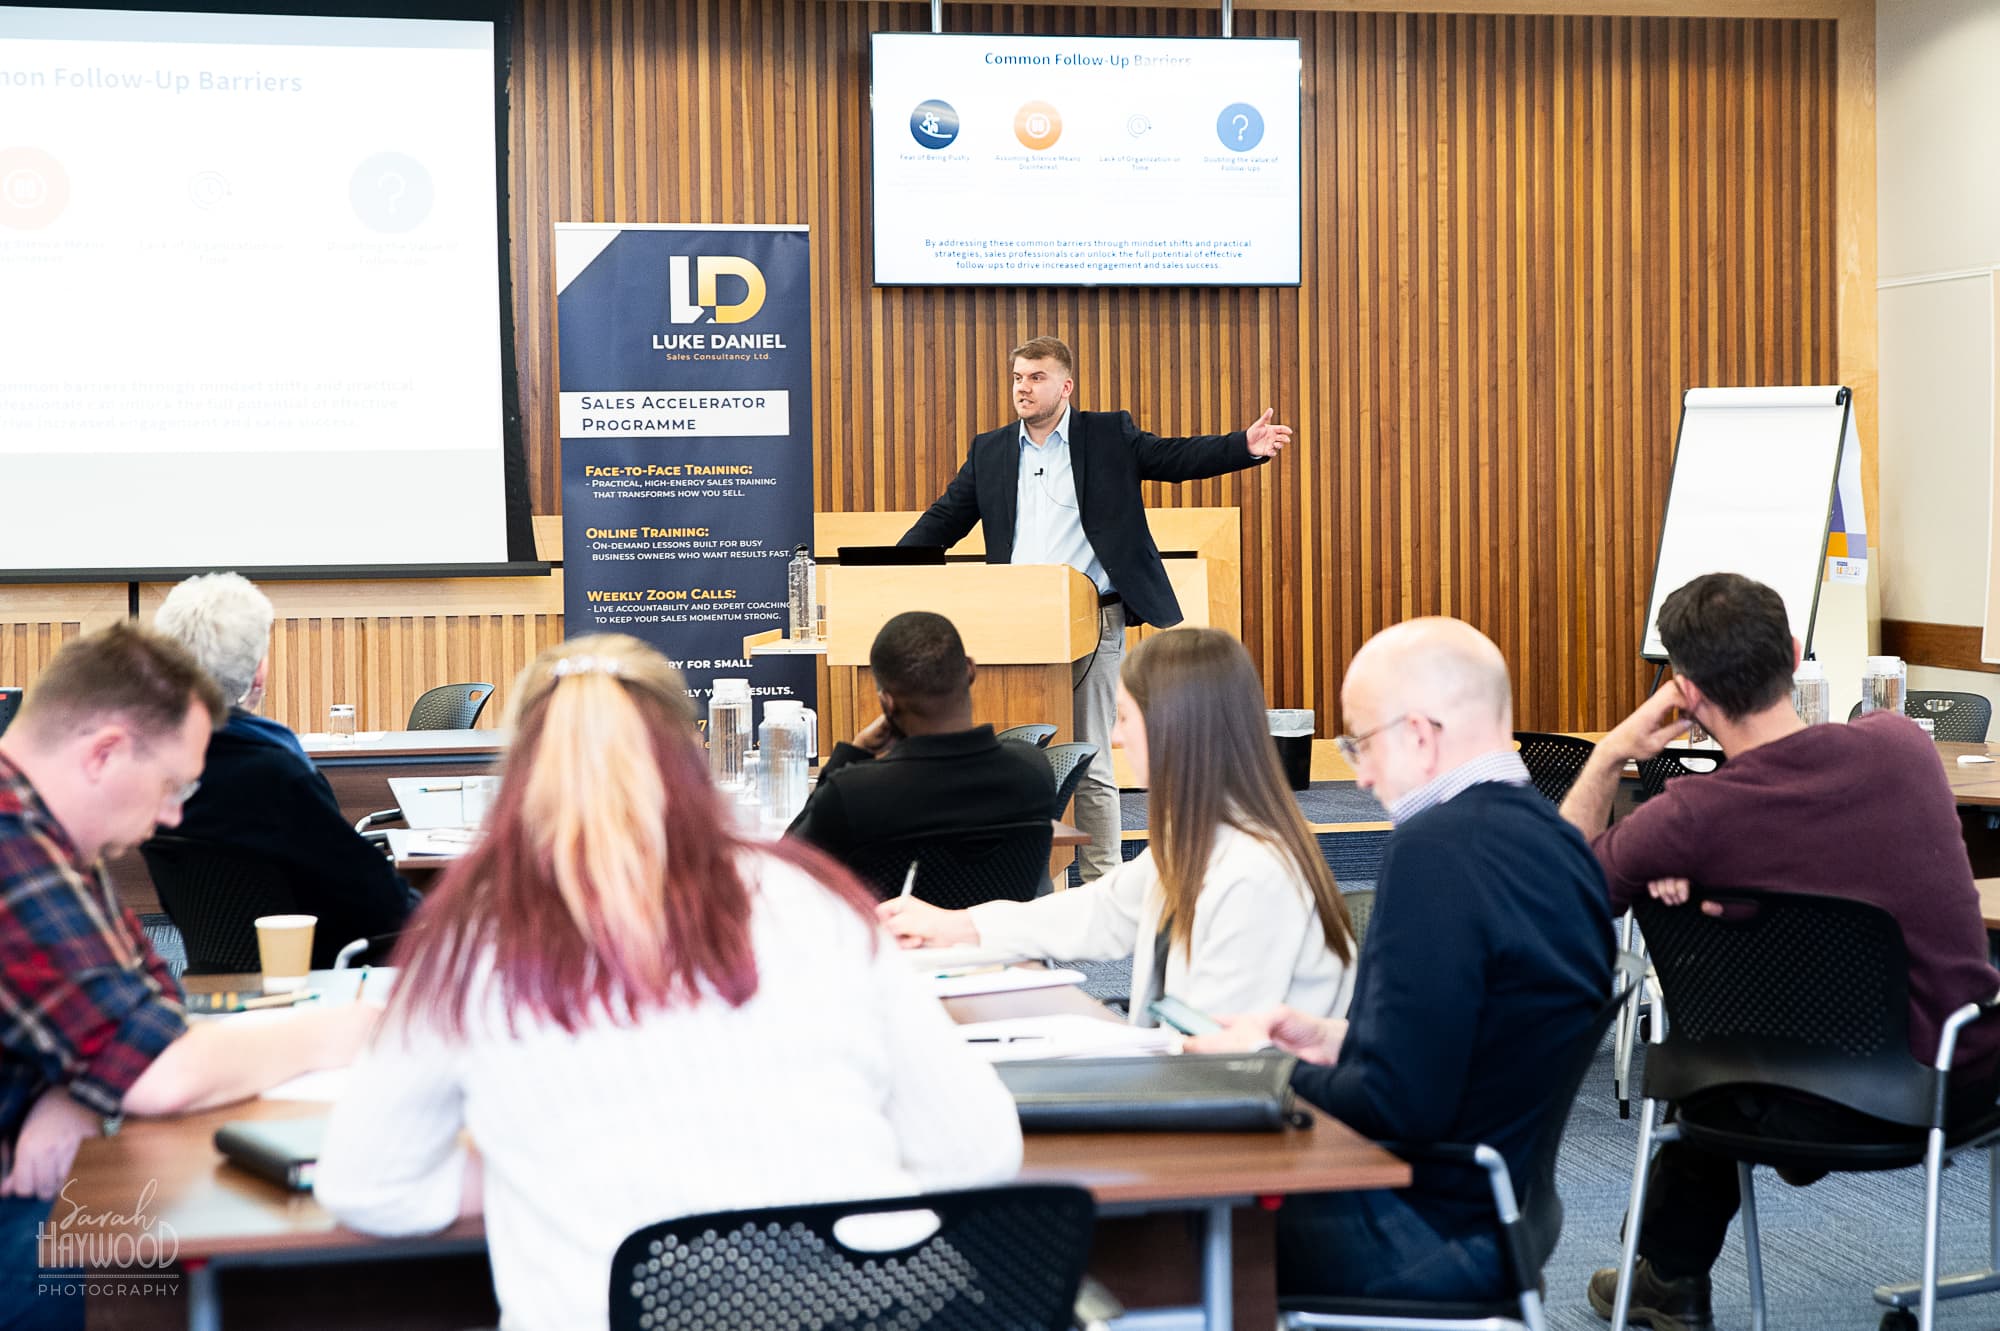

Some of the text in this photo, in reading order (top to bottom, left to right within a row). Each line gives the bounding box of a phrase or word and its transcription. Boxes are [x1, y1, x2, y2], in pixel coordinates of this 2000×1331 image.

[985, 52, 1193, 69] Common Follow-Up Barriers
[54, 67, 190, 95] Follow-Up
[199, 71, 304, 92] Barriers
[925, 239, 936, 248] By
[938, 239, 988, 248] addressing
[989, 239, 1014, 247] these
[1056, 239, 1092, 247] barriers
[1094, 240, 1129, 248] through
[1213, 240, 1252, 248] practical
[934, 250, 983, 259] strategies,
[1008, 250, 1068, 259] professionals
[1087, 250, 1116, 258] unlock
[1119, 250, 1134, 258] the
[1135, 250, 1150, 258] full
[1152, 250, 1192, 259] potential
[1194, 250, 1203, 258] of
[1204, 250, 1243, 258] effective
[956, 261, 1004, 270] follow-ups
[1017, 261, 1040, 269] drive
[1042, 261, 1085, 269] increased
[1087, 262, 1142, 270] engagement
[1143, 261, 1160, 269] and
[1162, 261, 1184, 269] sales
[652, 333, 787, 350] LUKE DANIEL
[666, 353, 691, 361] Sales
[693, 353, 751, 362] Consultancy
[645, 479, 705, 487] HIGH-ENERGY
[707, 478, 734, 487] SALES
[735, 478, 777, 486] TRAINING
[593, 491, 616, 499] THAT
[617, 490, 676, 499] TRANSFORMS
[678, 490, 700, 498] HOW
[722, 489, 746, 497] SELL.
[652, 541, 691, 549] LESSONS
[693, 540, 718, 548] BUILT
[719, 540, 738, 548] FOR
[592, 553, 635, 561] BUSINESS
[637, 552, 676, 560] OWNERS
[702, 551, 728, 559] WANT
[769, 550, 792, 558] FAST.
[616, 603, 690, 612] ACCOUNTABILITY
[691, 603, 710, 611] AND
[712, 602, 745, 610] EXPERT
[595, 616, 607, 624] TO
[634, 615, 659, 623] YOUR
[661, 614, 687, 622] SALES
[689, 613, 742, 622] MOMENTUM
[744, 612, 781, 621] STRONG.
[664, 659, 753, 670] RY FOR SMALL
[751, 686, 795, 697] ESULTS.
